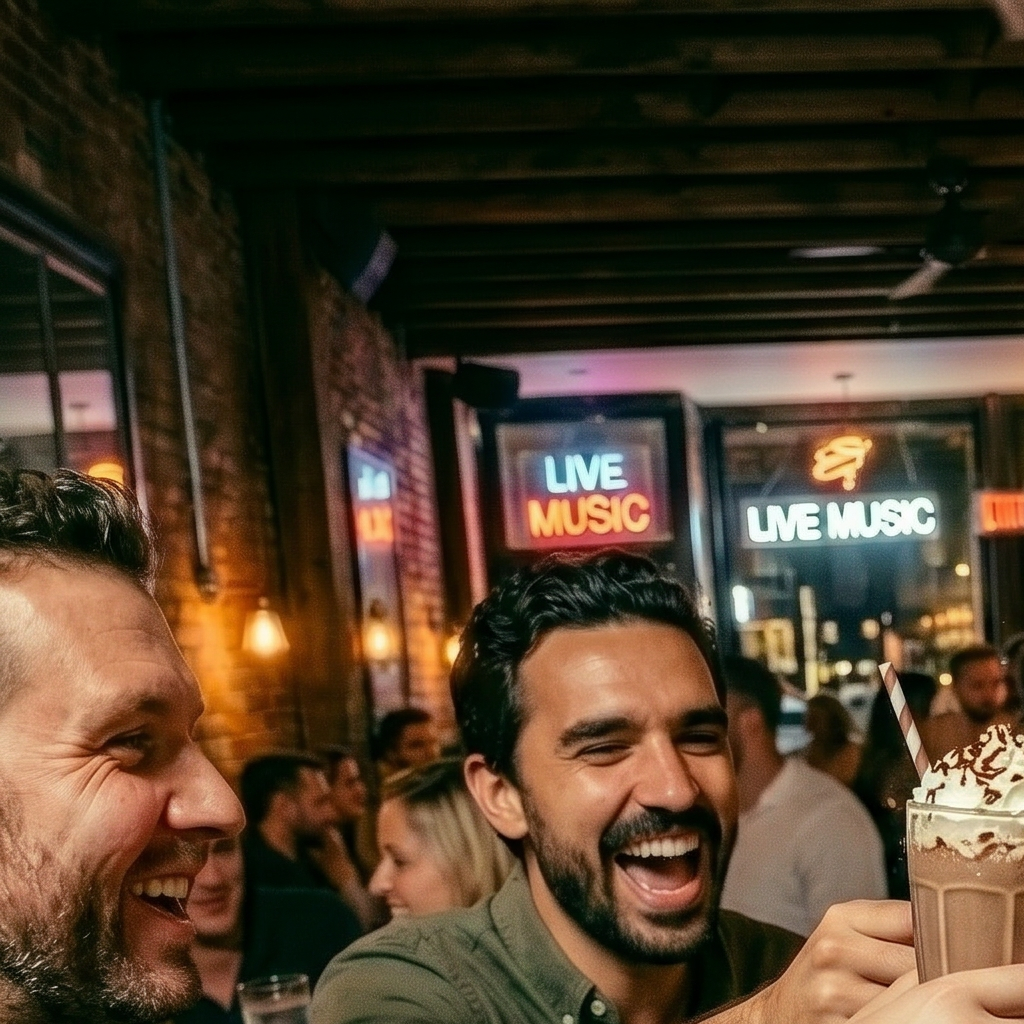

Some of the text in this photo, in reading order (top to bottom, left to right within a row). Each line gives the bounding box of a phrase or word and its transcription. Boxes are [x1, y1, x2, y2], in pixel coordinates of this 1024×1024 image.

[544, 453, 629, 493] LIVE
[528, 493, 650, 538] MUSIC
[747, 503, 822, 543] LIVE
[826, 497, 936, 540] MUSIC
